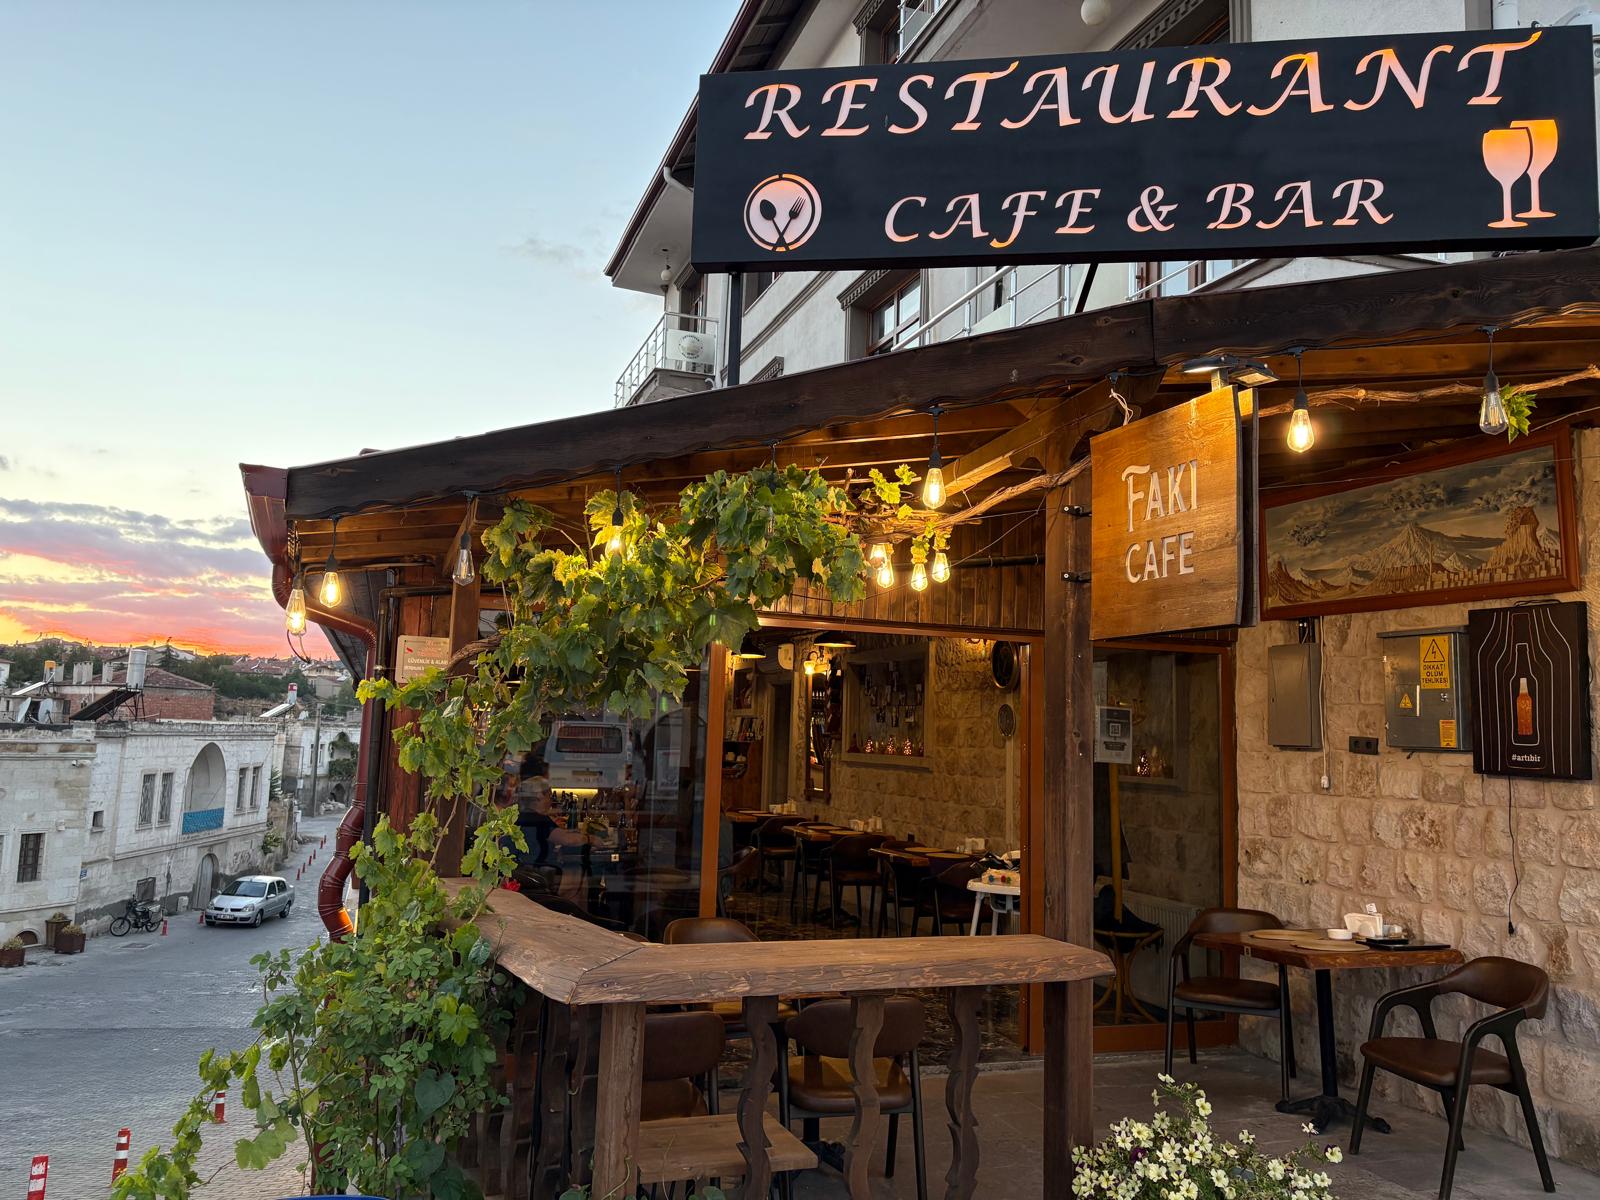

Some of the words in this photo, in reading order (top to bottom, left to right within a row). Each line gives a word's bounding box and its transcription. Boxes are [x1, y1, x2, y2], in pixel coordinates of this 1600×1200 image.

[744, 31, 1542, 140] RESTAURANT
[885, 188, 1102, 249] CAFE
[1127, 185, 1179, 233] &
[1207, 178, 1394, 230] BAR
[1121, 458, 1198, 533] FAKI
[1125, 530, 1195, 584] CAFE
